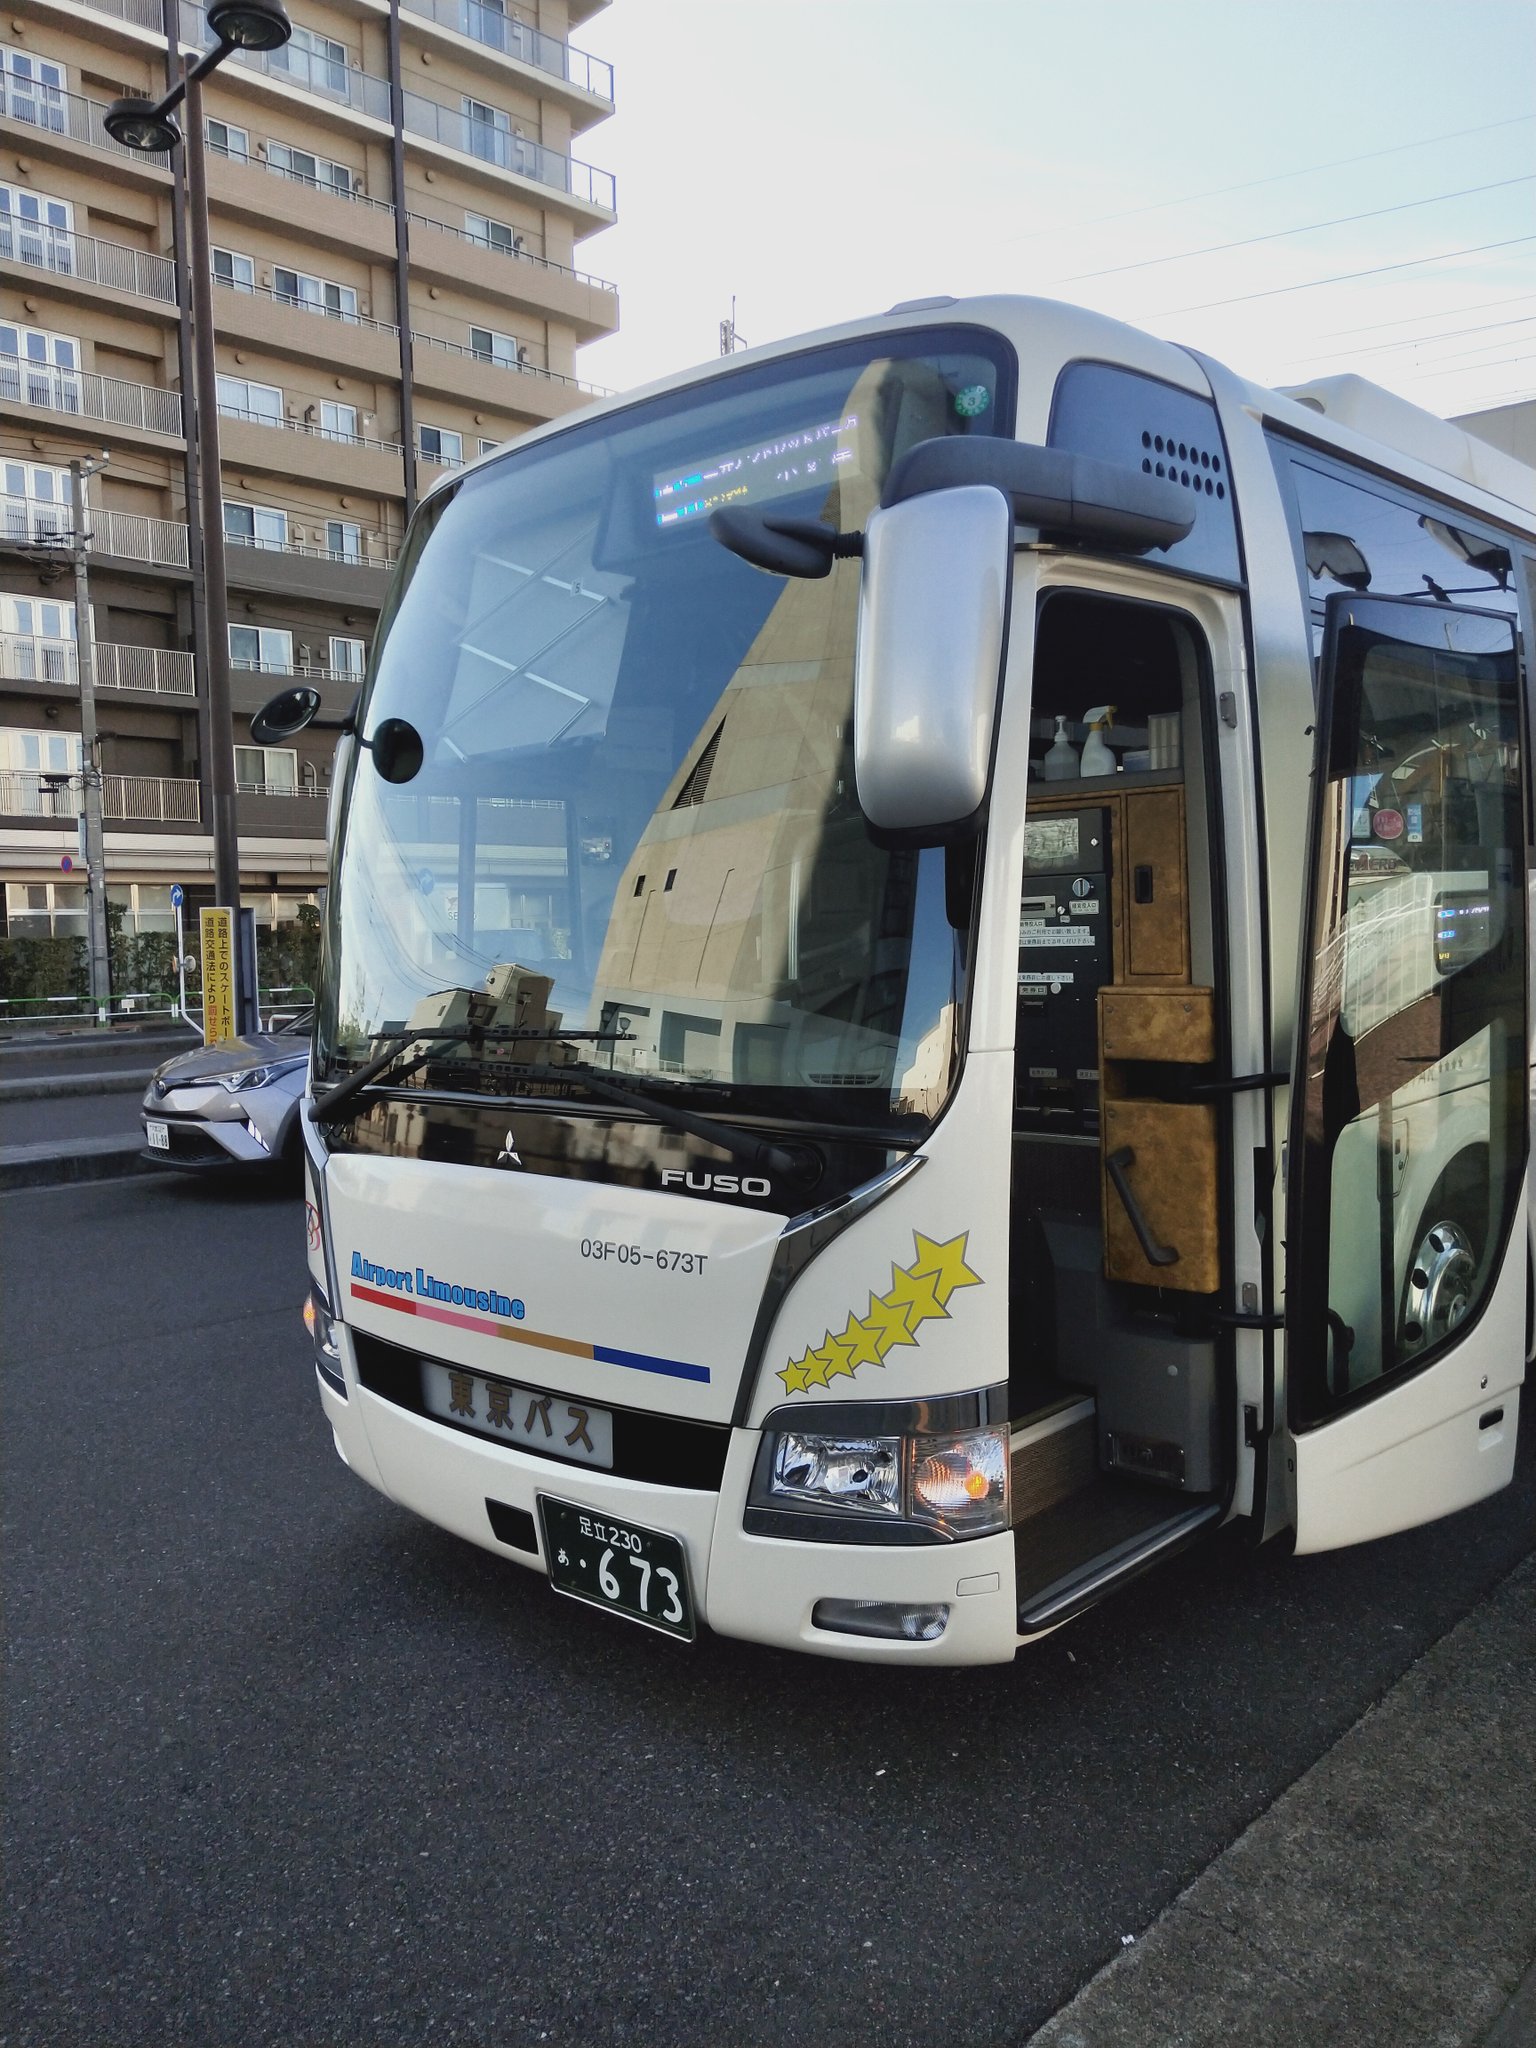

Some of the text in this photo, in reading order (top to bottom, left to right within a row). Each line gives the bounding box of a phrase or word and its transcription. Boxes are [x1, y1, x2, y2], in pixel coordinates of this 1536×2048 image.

[217, 917, 231, 1041] 道路上でのスケートボー
[661, 1169, 771, 1197] FUSO
[351, 1251, 525, 1320] Airport Limousine
[580, 1238, 709, 1275] 03F05-673T
[448, 1371, 594, 1453] 東京バス
